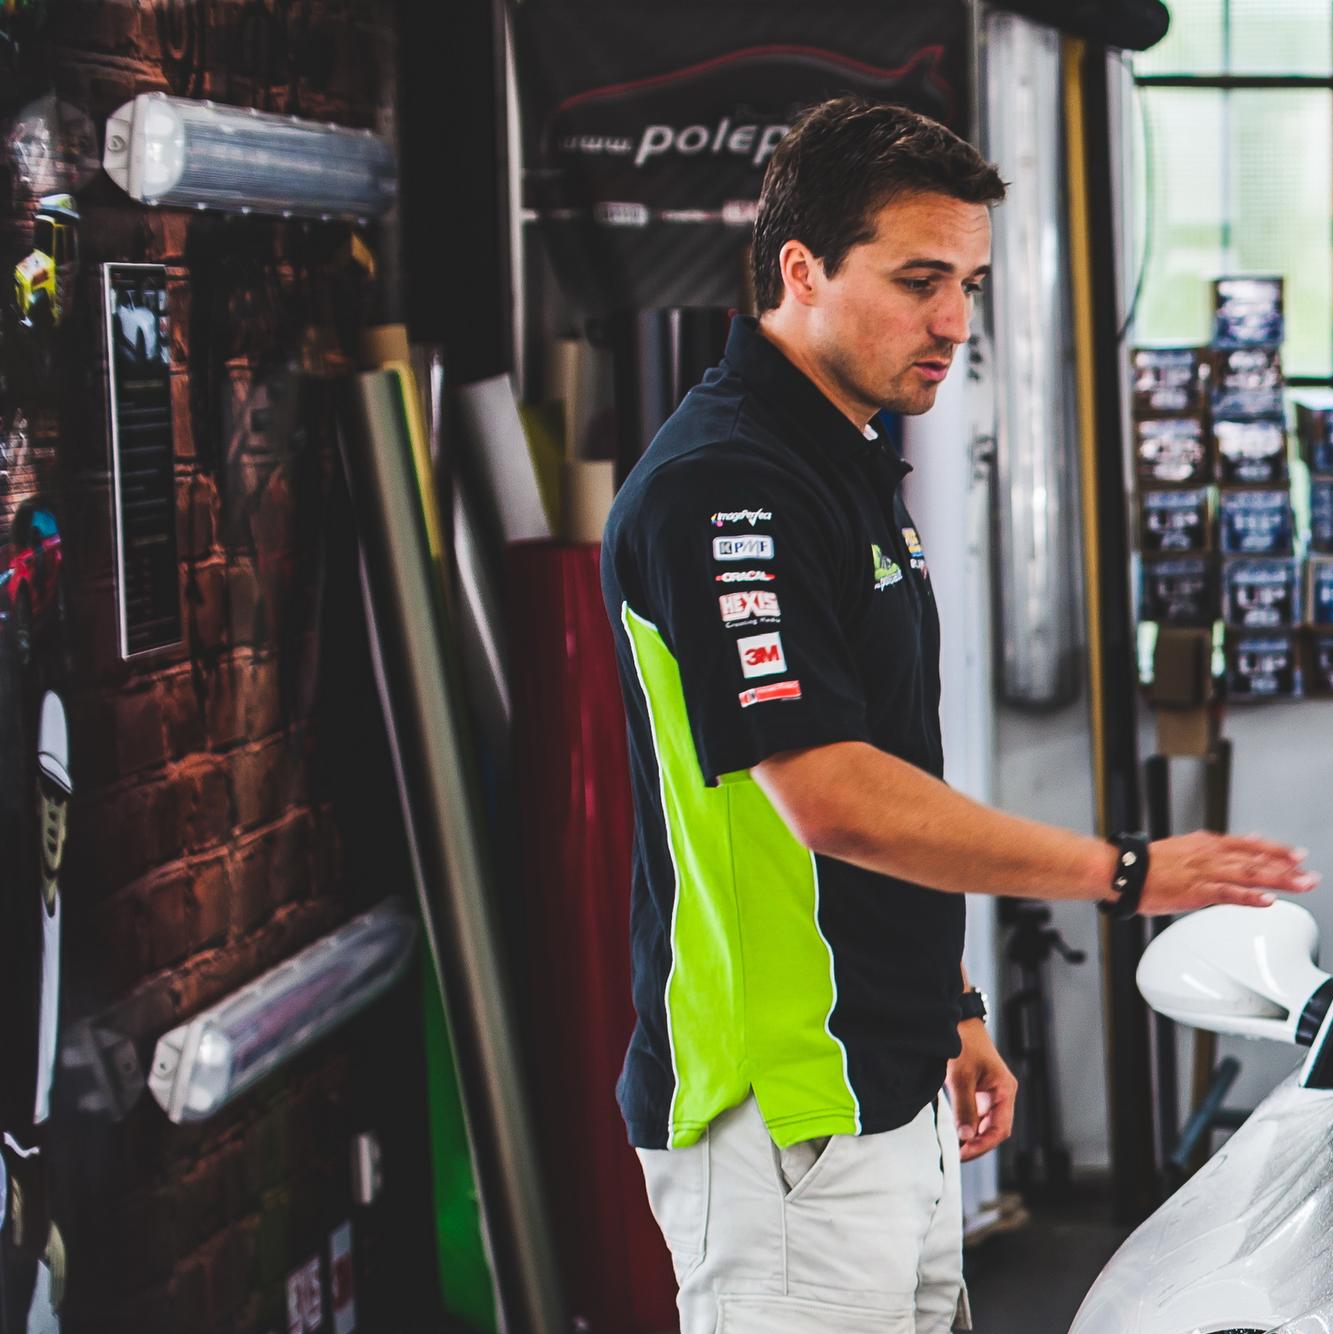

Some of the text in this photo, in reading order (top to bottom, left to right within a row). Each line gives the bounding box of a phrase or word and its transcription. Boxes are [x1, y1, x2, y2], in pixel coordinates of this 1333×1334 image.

[719, 540, 769, 555] KPMF
[719, 591, 781, 622] HEXIS
[745, 644, 780, 666] 3M
